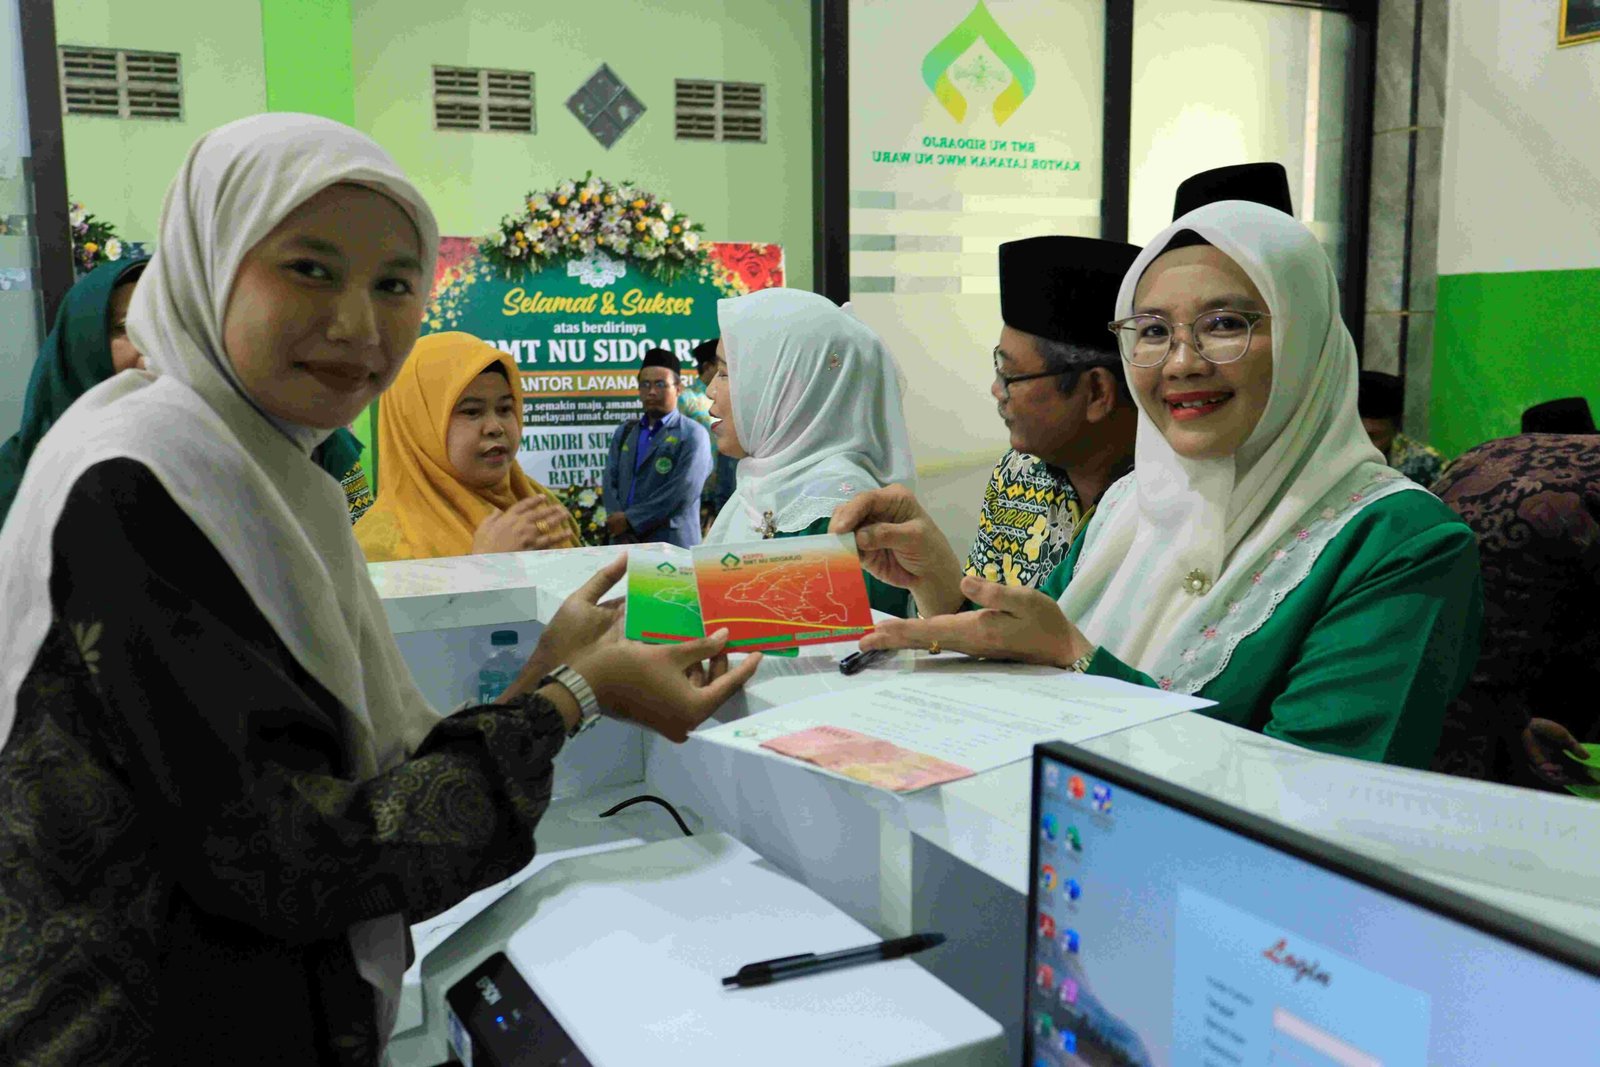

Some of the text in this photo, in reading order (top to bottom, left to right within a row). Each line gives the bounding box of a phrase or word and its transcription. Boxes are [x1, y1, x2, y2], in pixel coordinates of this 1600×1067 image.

[502, 287, 694, 316] Selamat & Sukses
[553, 321, 646, 336] atas berdirinya
[485, 339, 541, 363] MT
[547, 339, 587, 363] NU
[520, 376, 573, 391] ANTOR
[577, 375, 640, 390] LAYANA
[535, 400, 576, 411] semakin
[606, 399, 643, 410] amanah
[531, 411, 575, 423] melayani
[577, 411, 601, 421] umat
[603, 410, 638, 421] dengan
[520, 431, 613, 452] MANDIRI SUK
[1263, 937, 1332, 987] Login
